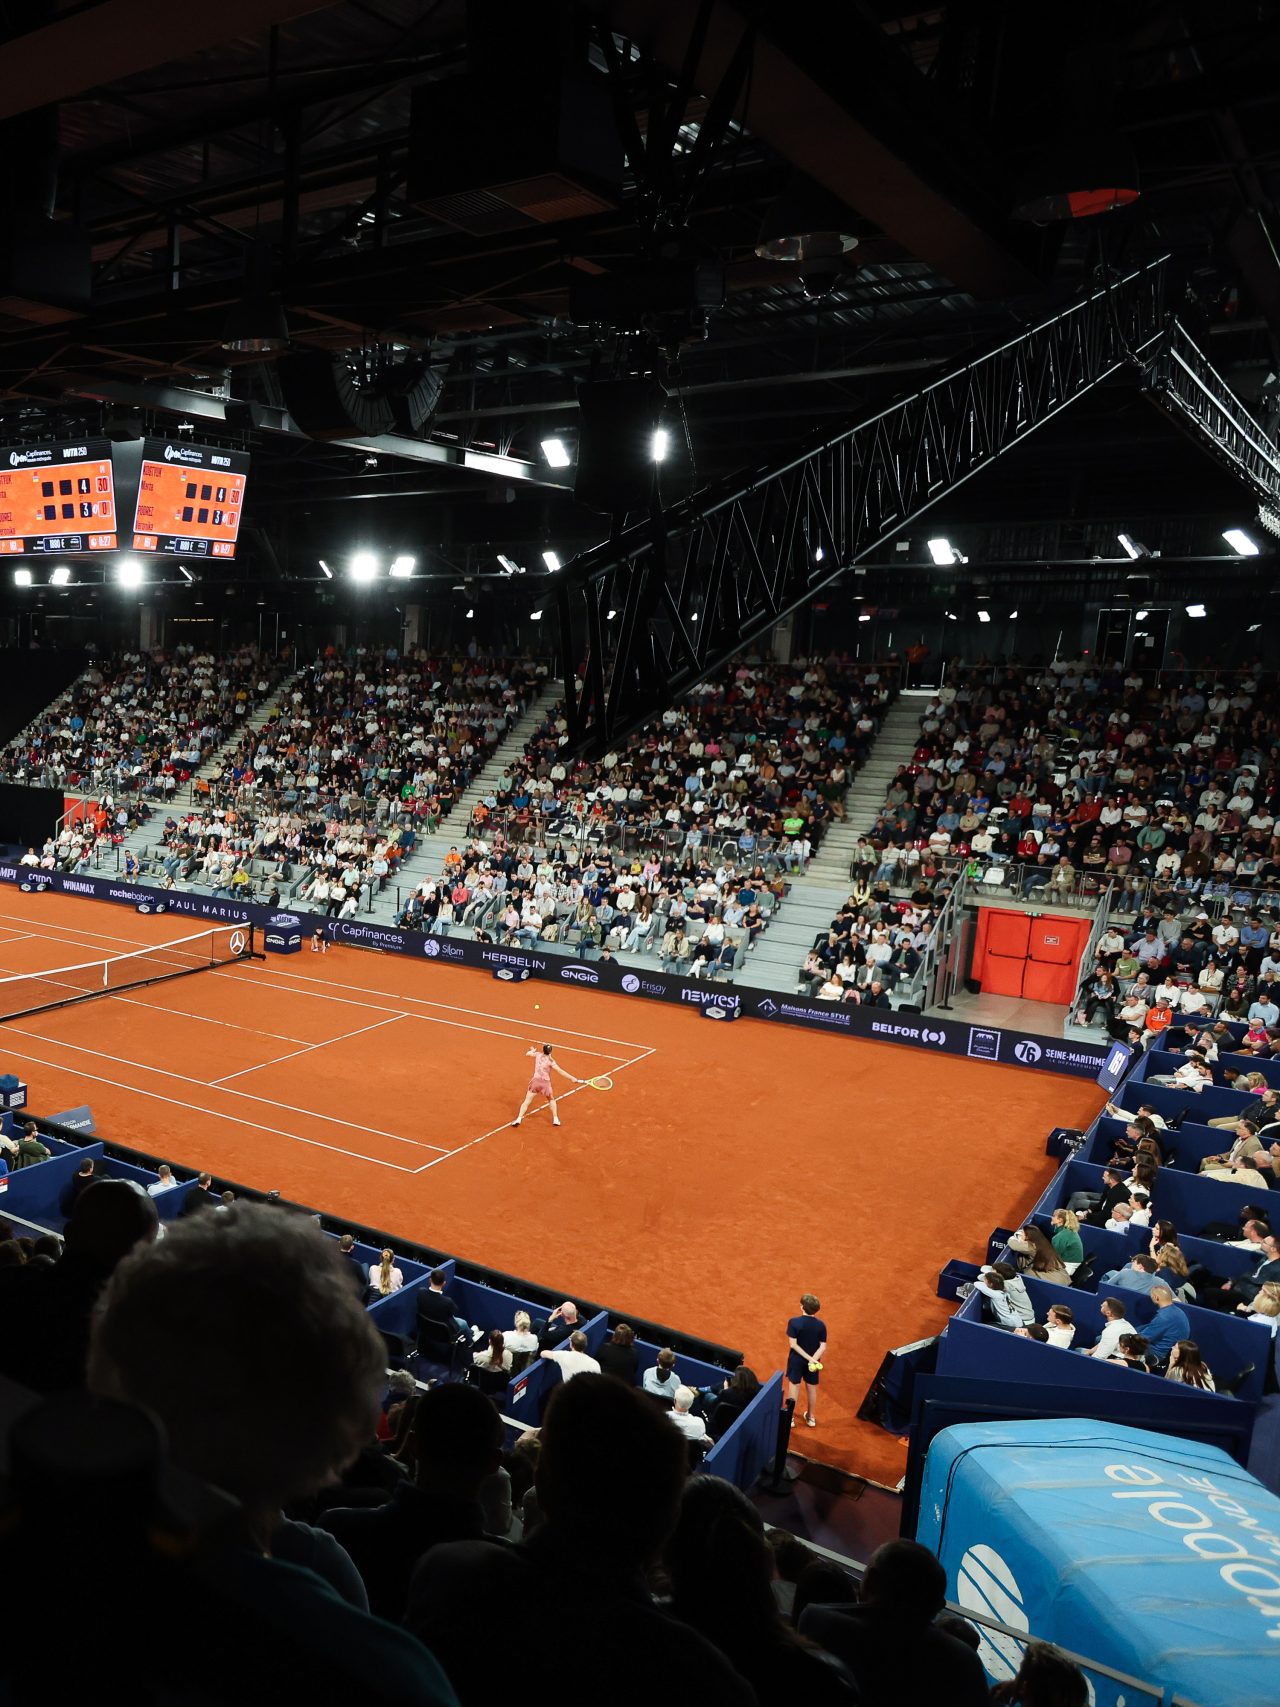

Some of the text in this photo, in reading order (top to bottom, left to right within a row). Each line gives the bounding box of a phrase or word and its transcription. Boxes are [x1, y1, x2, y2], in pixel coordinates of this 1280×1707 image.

[81, 480, 87, 493] 4
[98, 478, 107, 492] 30
[218, 488, 223, 501] 4
[83, 503, 88, 516] 3
[102, 502, 107, 515] 0
[0, 867, 17, 880] MPI
[63, 879, 95, 895] WINAMAX
[169, 899, 248, 920] PAUL MARIUS
[482, 951, 546, 970] HERBELIN
[780, 1003, 807, 1013] Maisons
[807, 1008, 829, 1017] France
[830, 1012, 851, 1021] STYLE
[872, 1021, 920, 1039] BELFOR
[1018, 1040, 1037, 1063] 76
[1045, 1048, 1106, 1067] SEINE-MARITIME
